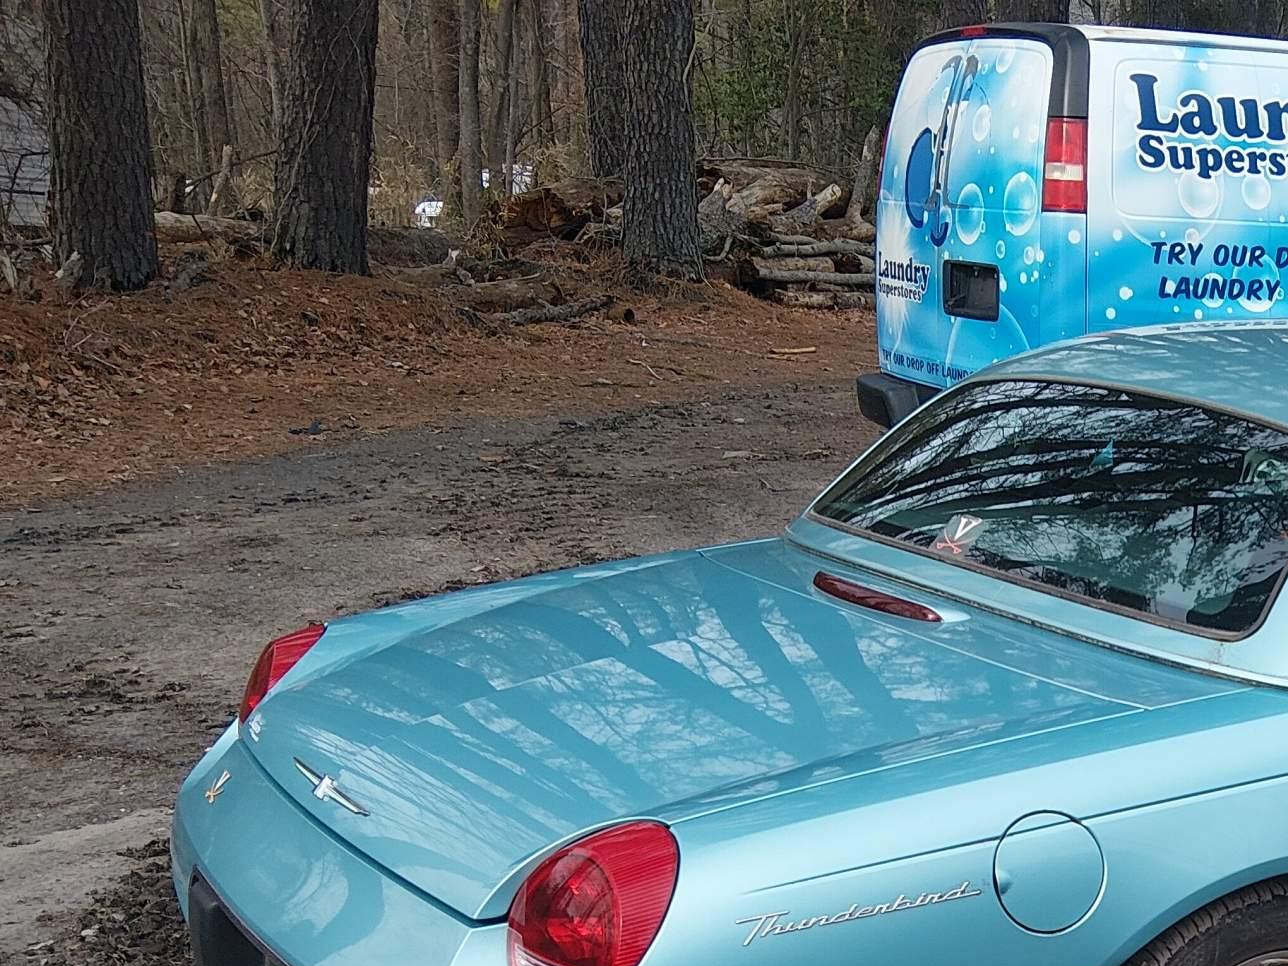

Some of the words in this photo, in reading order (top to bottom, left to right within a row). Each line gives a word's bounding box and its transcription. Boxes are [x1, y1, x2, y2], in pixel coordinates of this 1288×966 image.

[1151, 242, 1203, 266] TRY
[1213, 245, 1265, 267] OUR
[878, 251, 930, 292] Laundry
[1158, 277, 1281, 301] LAUNDRY
[906, 356, 924, 373] DROP
[926, 362, 939, 376] OFF
[735, 881, 982, 947] Thunderbird
